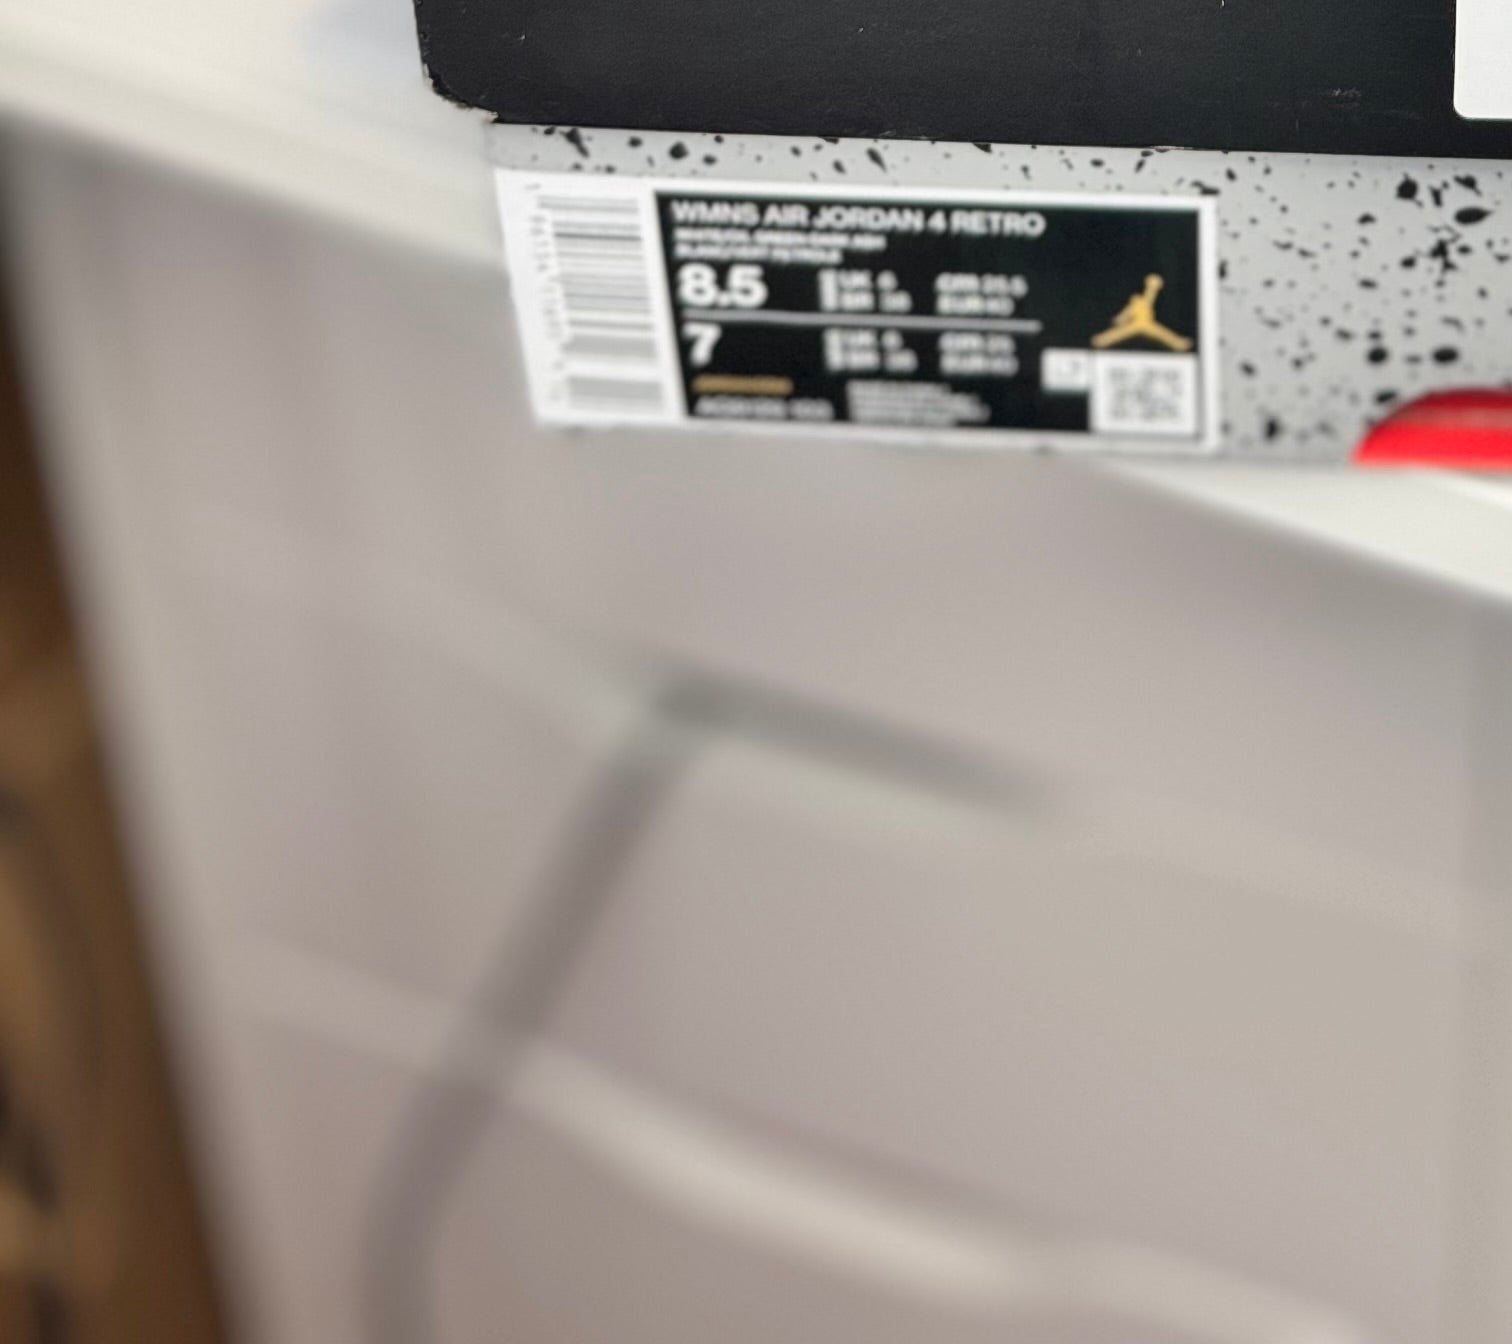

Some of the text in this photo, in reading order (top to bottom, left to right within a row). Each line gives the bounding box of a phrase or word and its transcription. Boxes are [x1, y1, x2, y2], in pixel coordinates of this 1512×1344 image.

[671, 200, 1047, 238] WMNS AIR JORDAN 4 RETRO
[677, 262, 768, 308] 8.5
[682, 322, 722, 368] 7
